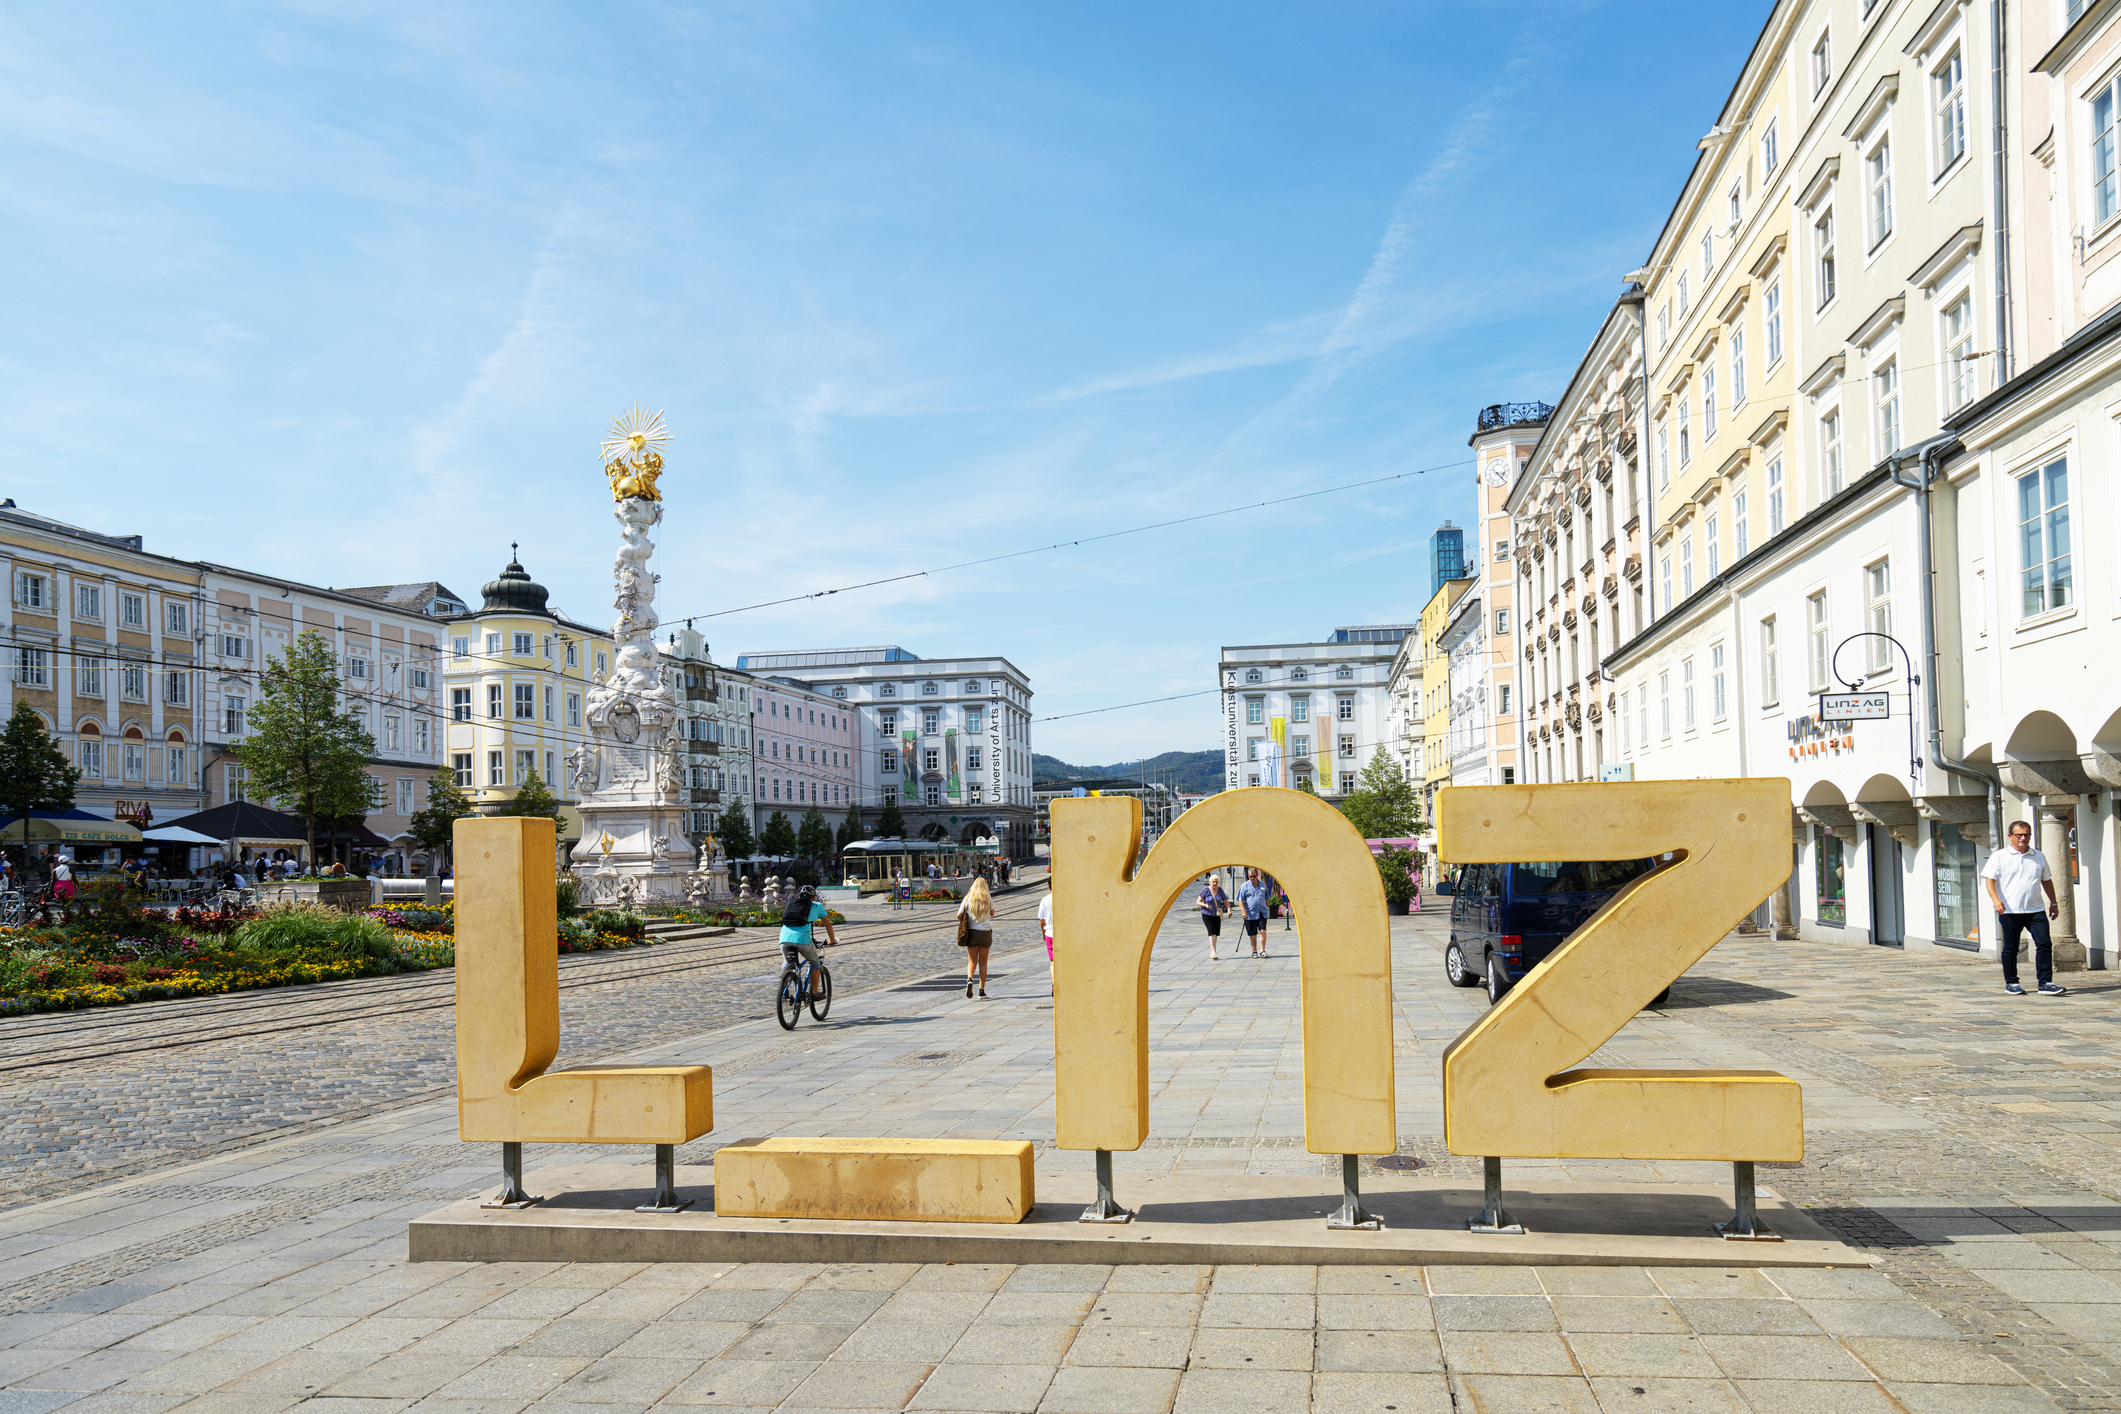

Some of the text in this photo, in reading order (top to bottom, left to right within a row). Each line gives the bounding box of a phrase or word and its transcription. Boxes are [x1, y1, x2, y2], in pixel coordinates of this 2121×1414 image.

[1826, 698, 1885, 709] LINZ AG
[990, 708, 999, 733] Arts
[1227, 671, 1240, 768] Kunstuniversität
[990, 734, 1000, 745] of
[1789, 735, 1854, 759] LINIEN
[990, 746, 1002, 803] University
[116, 800, 152, 815] RIVA
[104, 833, 130, 841] DOLCE
[1937, 868, 1956, 882] MOBIL
[1937, 881, 1952, 894] SEIN
[1938, 893, 1961, 908] KOMMT
[1938, 906, 1950, 919] AN.
